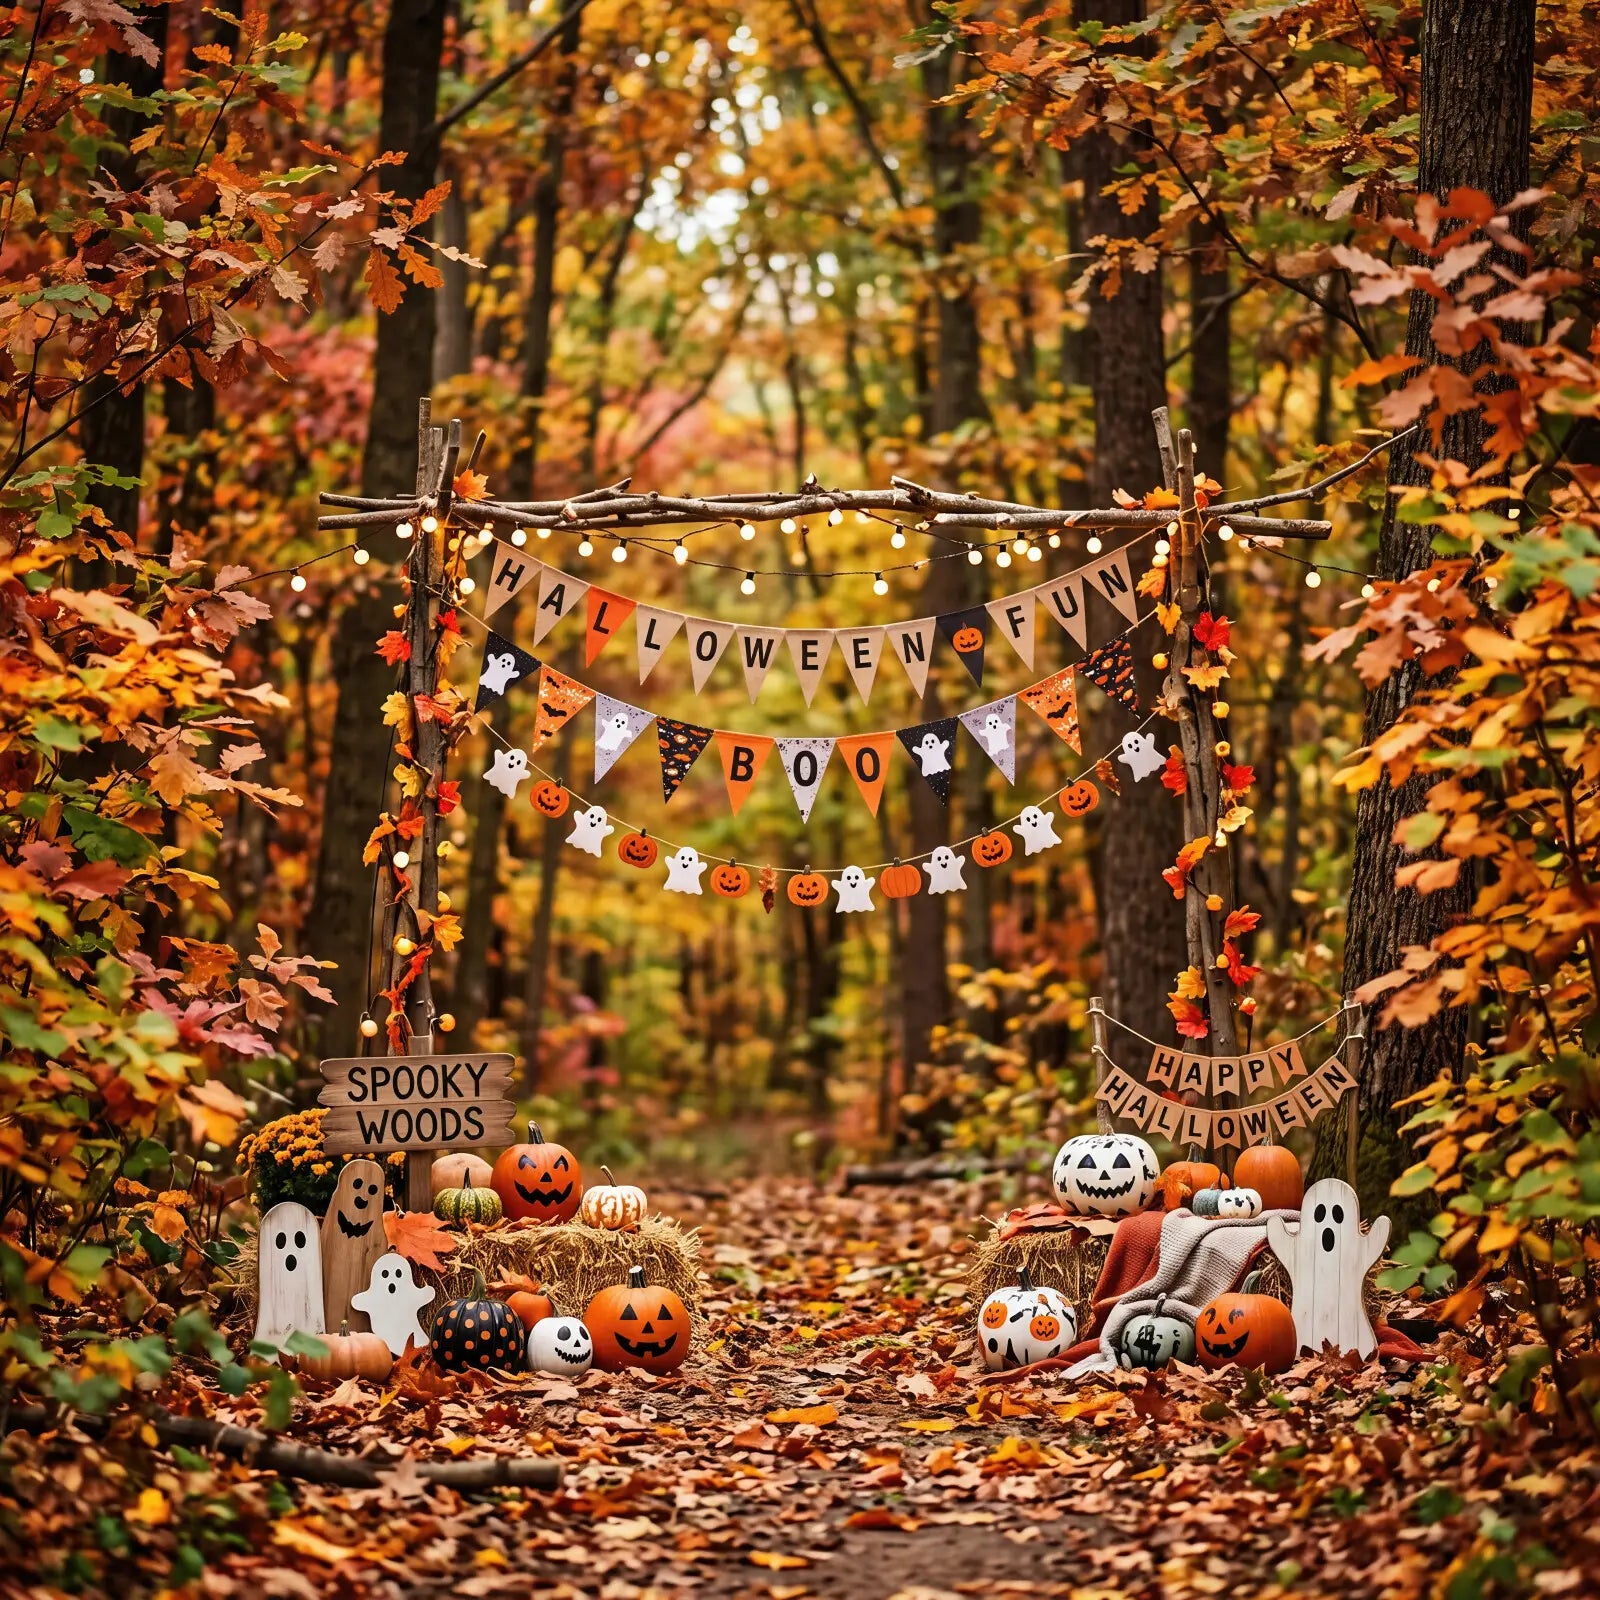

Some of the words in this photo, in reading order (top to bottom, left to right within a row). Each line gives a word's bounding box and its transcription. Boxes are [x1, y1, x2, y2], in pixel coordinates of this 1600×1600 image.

[494, 556, 927, 671] HALLOWEEN
[1008, 563, 1129, 638] FUN
[730, 746, 881, 787] BOO
[347, 1062, 489, 1102] SPOOKY
[1154, 1047, 1295, 1087] HAPPY
[1103, 1064, 1348, 1139] HALLOWEEN
[356, 1106, 485, 1145] WOODS
